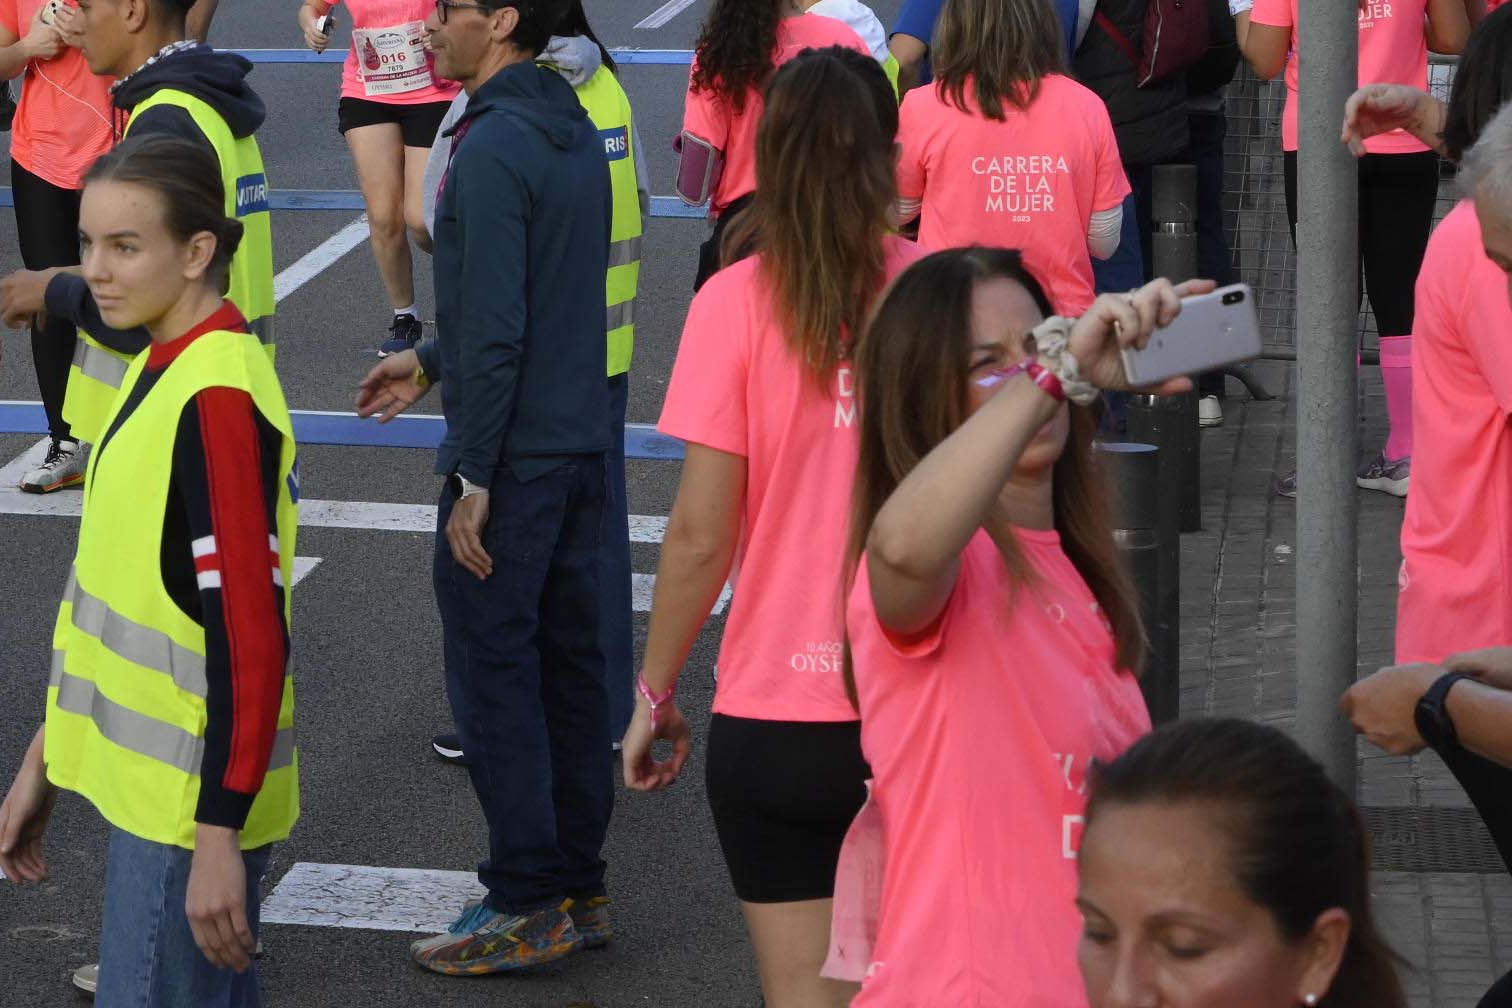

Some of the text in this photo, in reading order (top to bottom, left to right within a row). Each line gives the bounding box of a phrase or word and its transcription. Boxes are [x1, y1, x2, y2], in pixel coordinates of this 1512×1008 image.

[382, 52, 406, 64] 016
[971, 156, 1068, 174] CARRERA
[990, 175, 1051, 193] DE LA
[985, 193, 1055, 212] MUJER
[1012, 215, 1031, 223] 2023
[818, 640, 842, 652] AÑO
